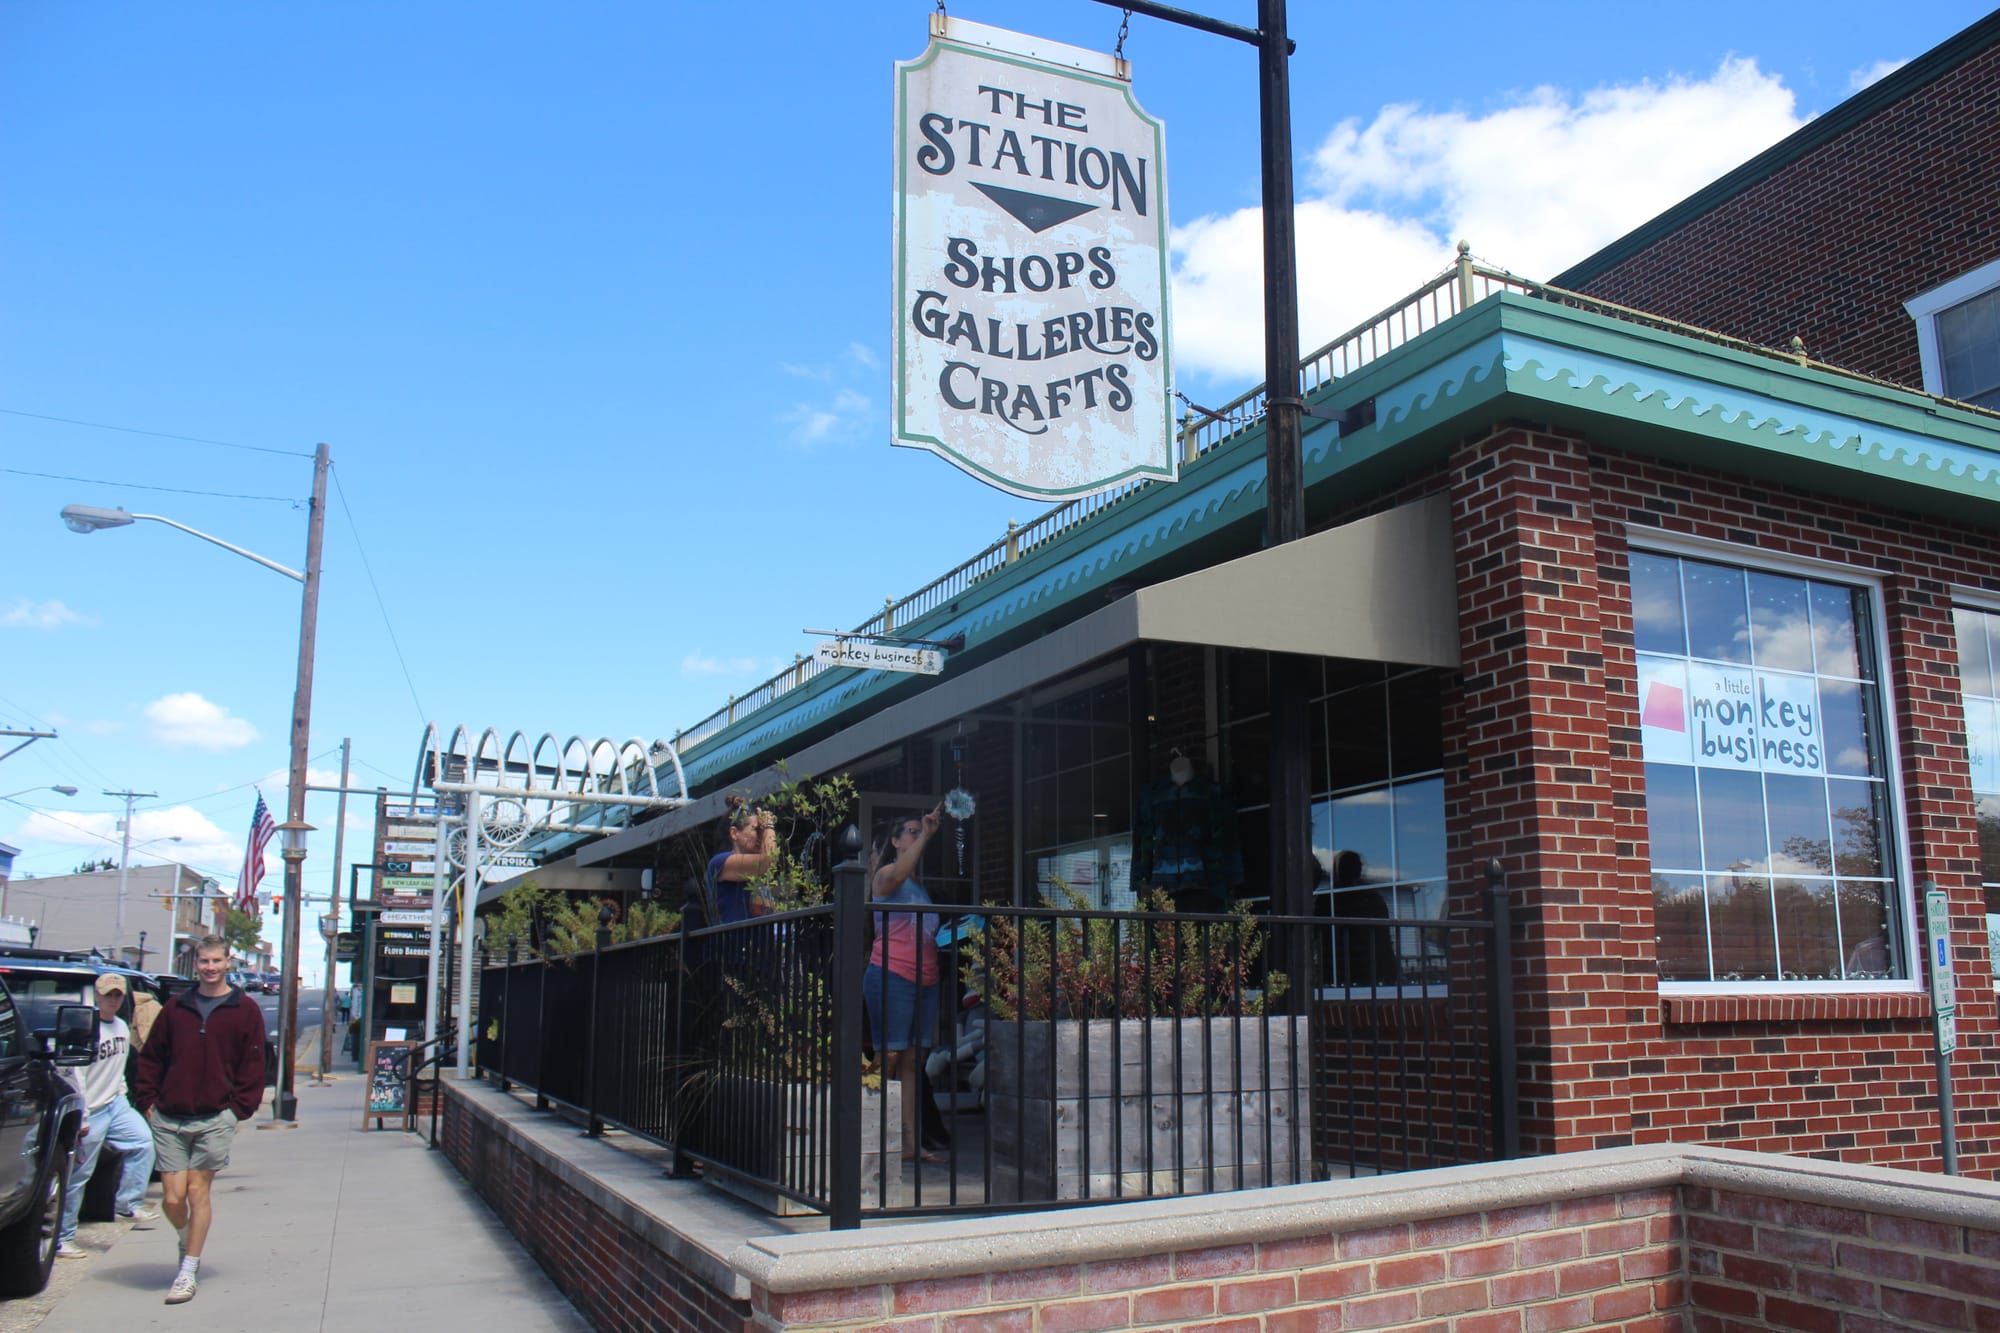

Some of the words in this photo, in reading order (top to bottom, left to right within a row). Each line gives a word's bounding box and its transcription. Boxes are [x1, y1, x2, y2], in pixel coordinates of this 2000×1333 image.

[978, 84, 1088, 133] THE
[917, 112, 1147, 216] STATION
[943, 236, 1116, 293] SHOPS
[912, 290, 1158, 361] GALLERIES
[939, 361, 1133, 435] CRAFTS
[820, 643, 870, 663] monkey
[874, 649, 923, 666] business
[1693, 677, 1812, 736] monkey
[1714, 682, 1721, 691] a
[1724, 677, 1750, 694] little
[1701, 720, 1819, 769] business
[496, 857, 535, 867] TROIKA
